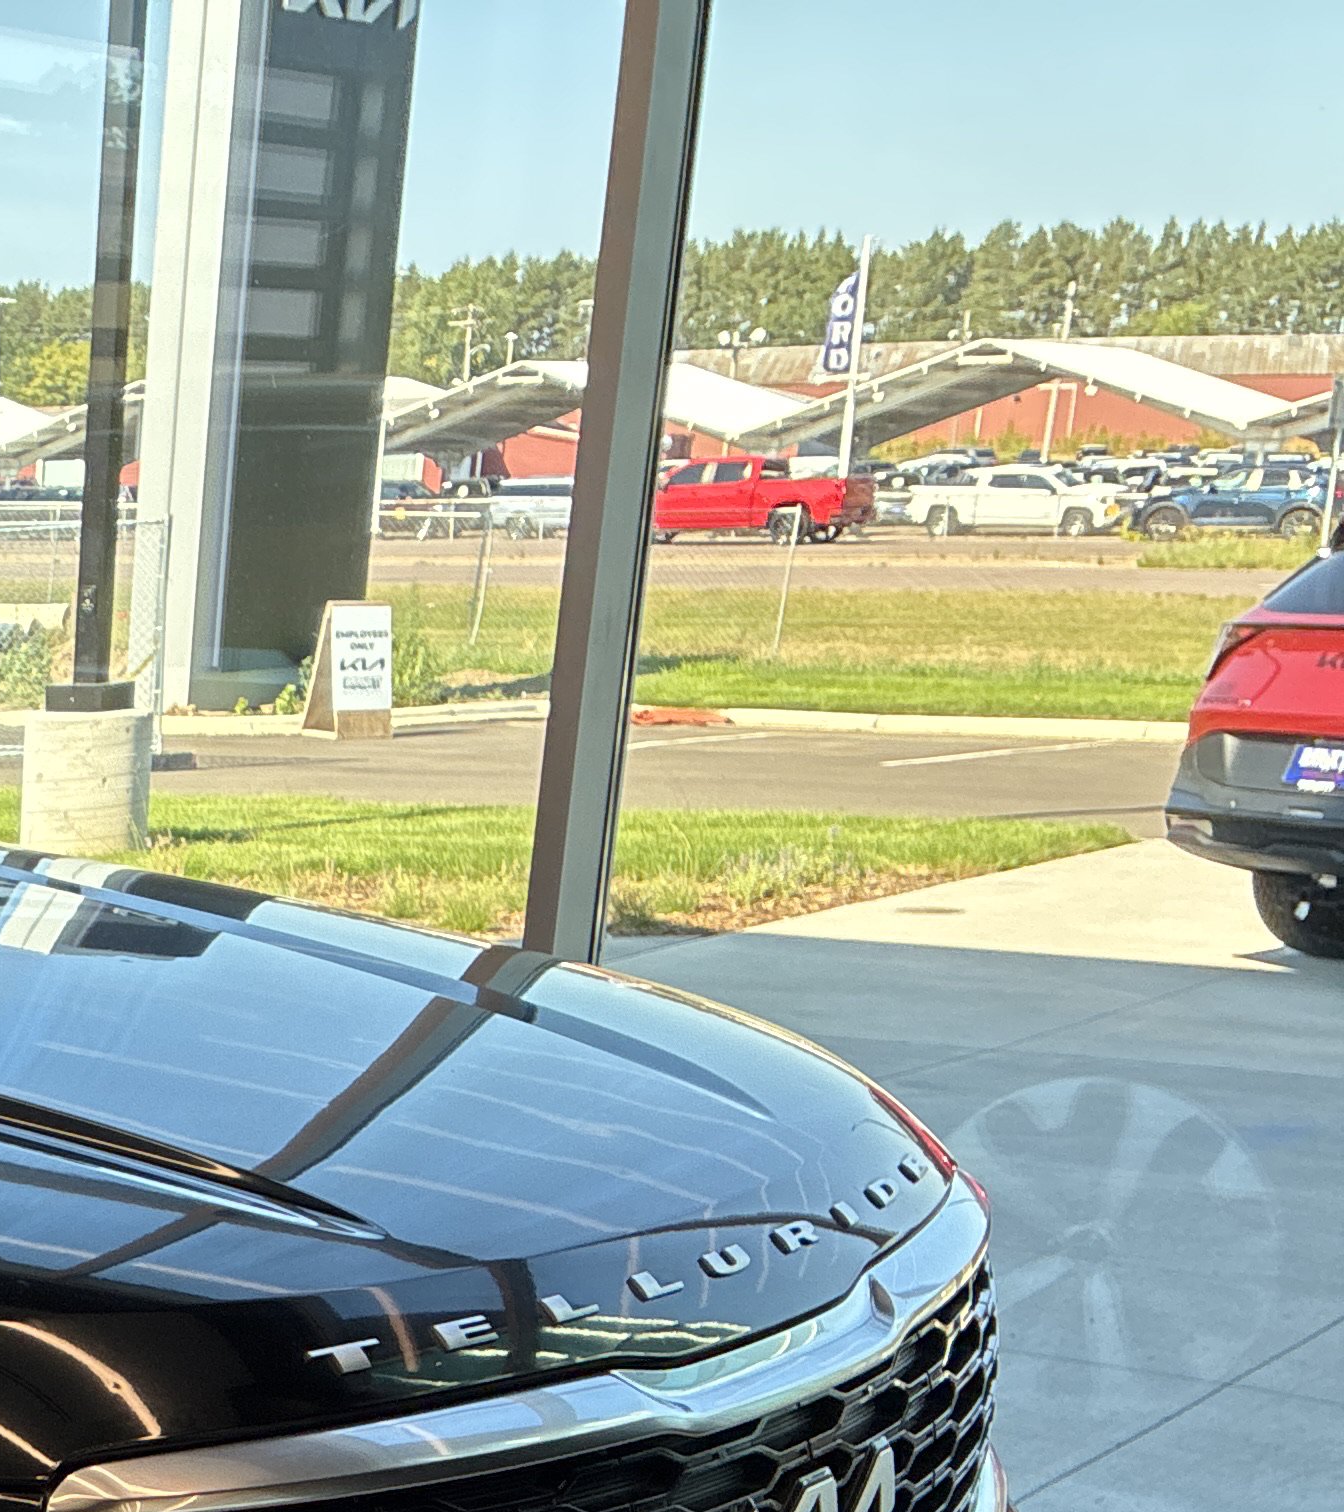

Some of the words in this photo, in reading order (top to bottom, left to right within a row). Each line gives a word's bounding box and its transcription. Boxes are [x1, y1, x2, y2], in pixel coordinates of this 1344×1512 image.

[335, 630, 389, 639] EMPLOYEES
[349, 641, 374, 650] ONLY
[340, 657, 385, 671] KIA
[304, 1152, 929, 1376] TELLURIDE
